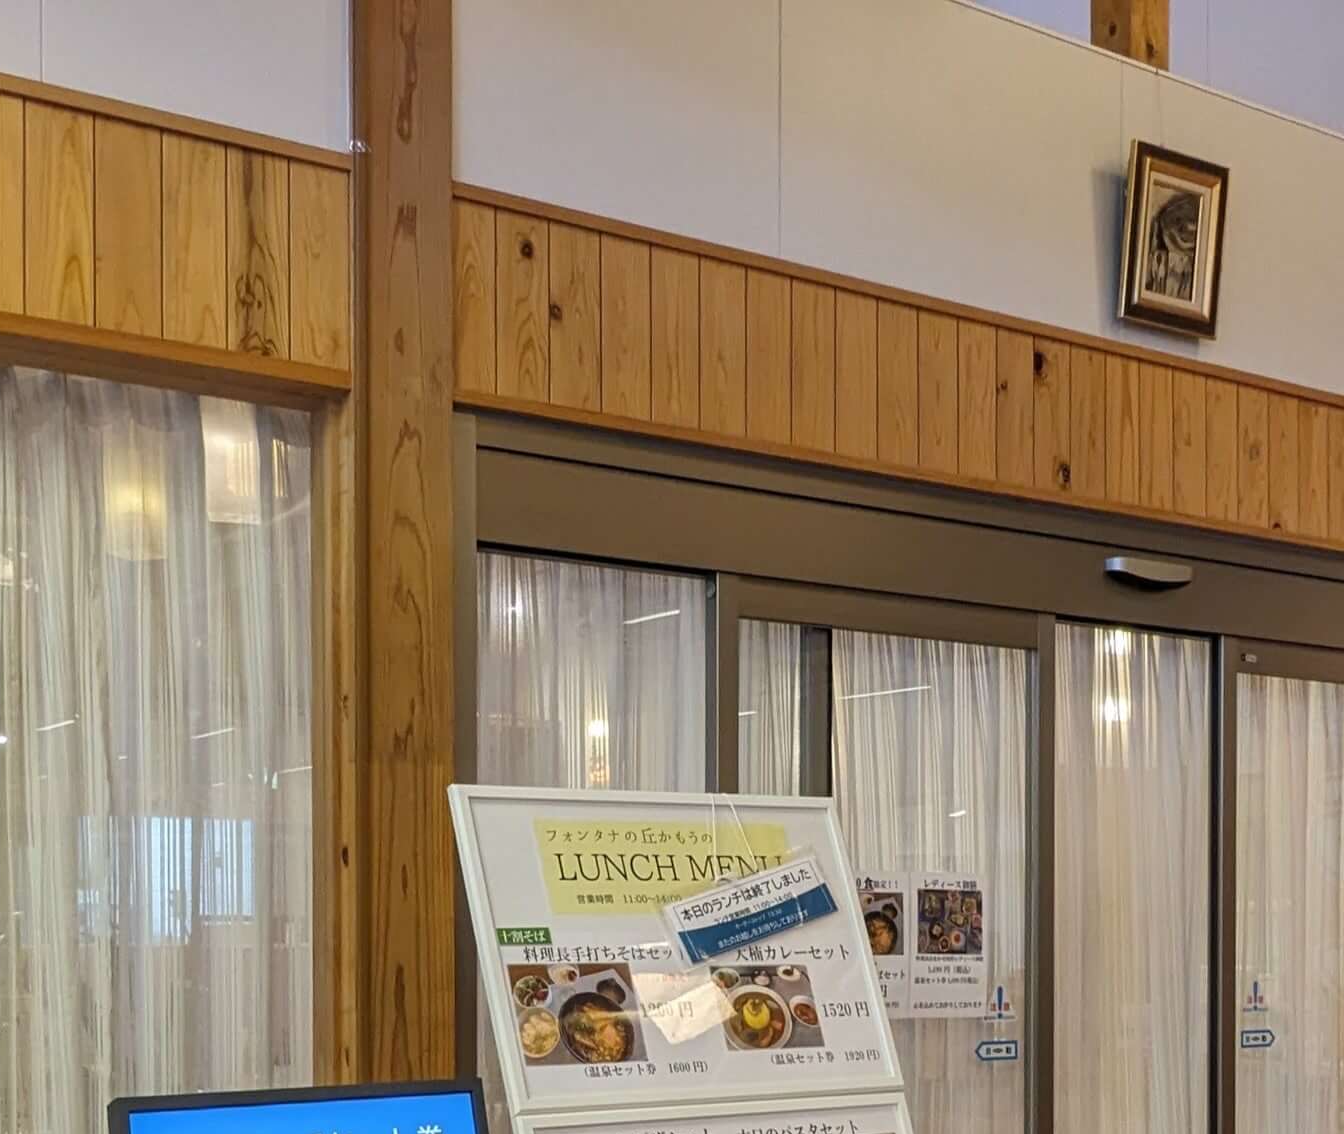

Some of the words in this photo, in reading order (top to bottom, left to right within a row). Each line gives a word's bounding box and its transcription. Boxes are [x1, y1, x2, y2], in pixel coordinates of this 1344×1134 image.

[546, 826, 713, 845] フォンタナの丘かもうの
[555, 853, 681, 881] LUNCH
[577, 893, 614, 905] 営業時間
[680, 868, 811, 922] 本日のランチは終了しました
[822, 1001, 871, 1018] 1520円
